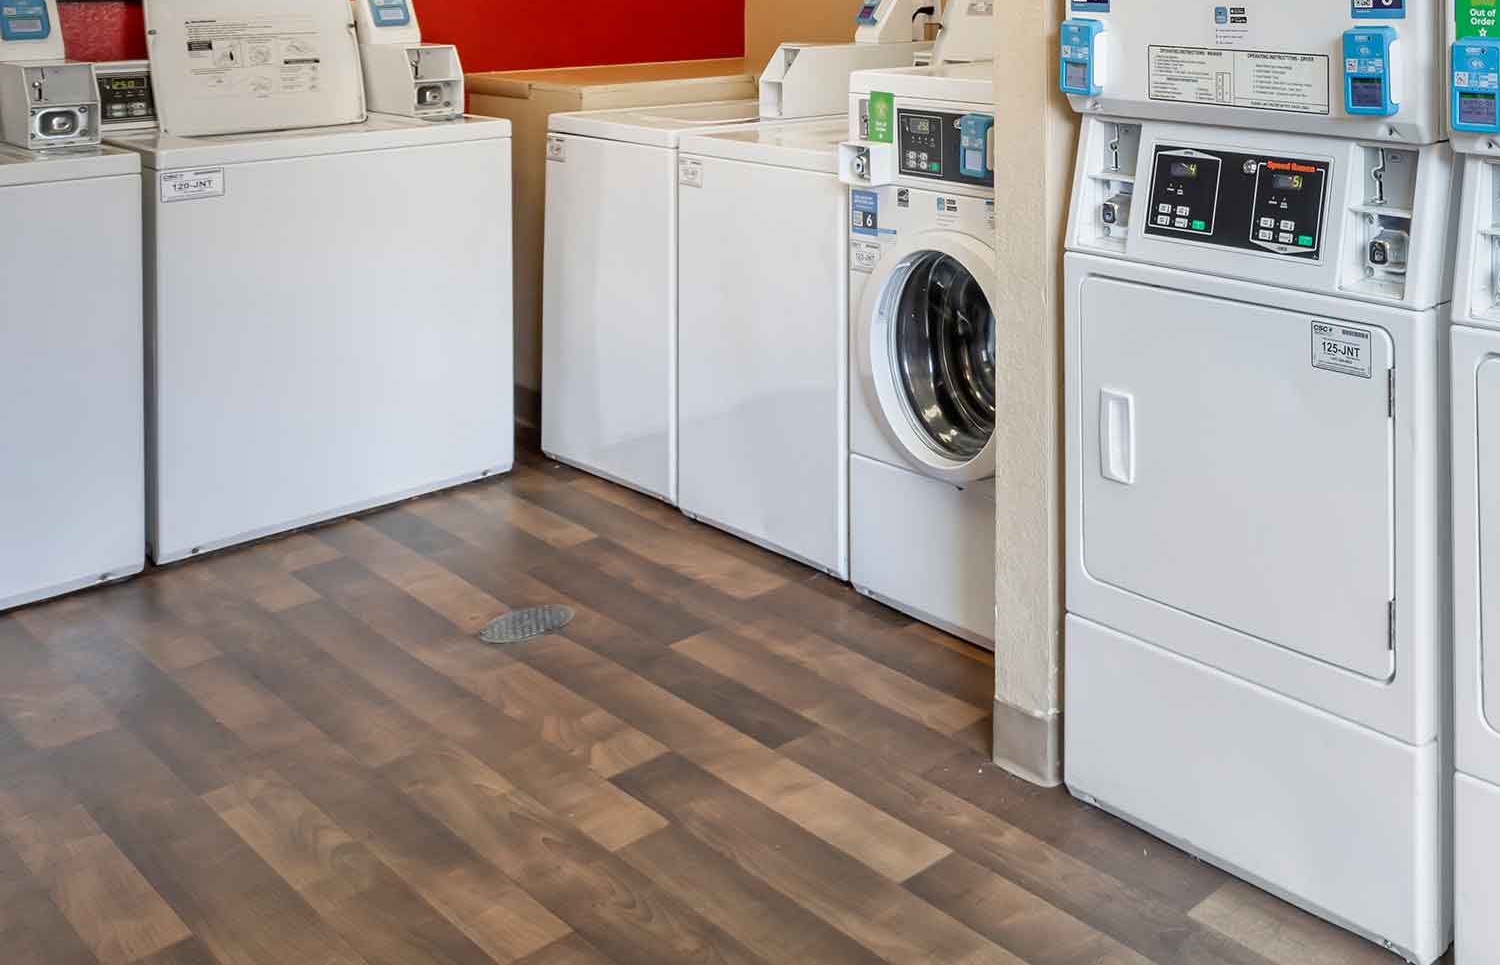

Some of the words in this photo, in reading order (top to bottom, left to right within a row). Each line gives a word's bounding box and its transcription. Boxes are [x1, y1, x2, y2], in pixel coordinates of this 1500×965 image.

[1470, 8, 1486, 17] Out
[1487, 8, 1496, 17] of
[1470, 17, 1496, 26] Order
[866, 214, 873, 228] 6
[1322, 342, 1361, 358] 125-JNT
